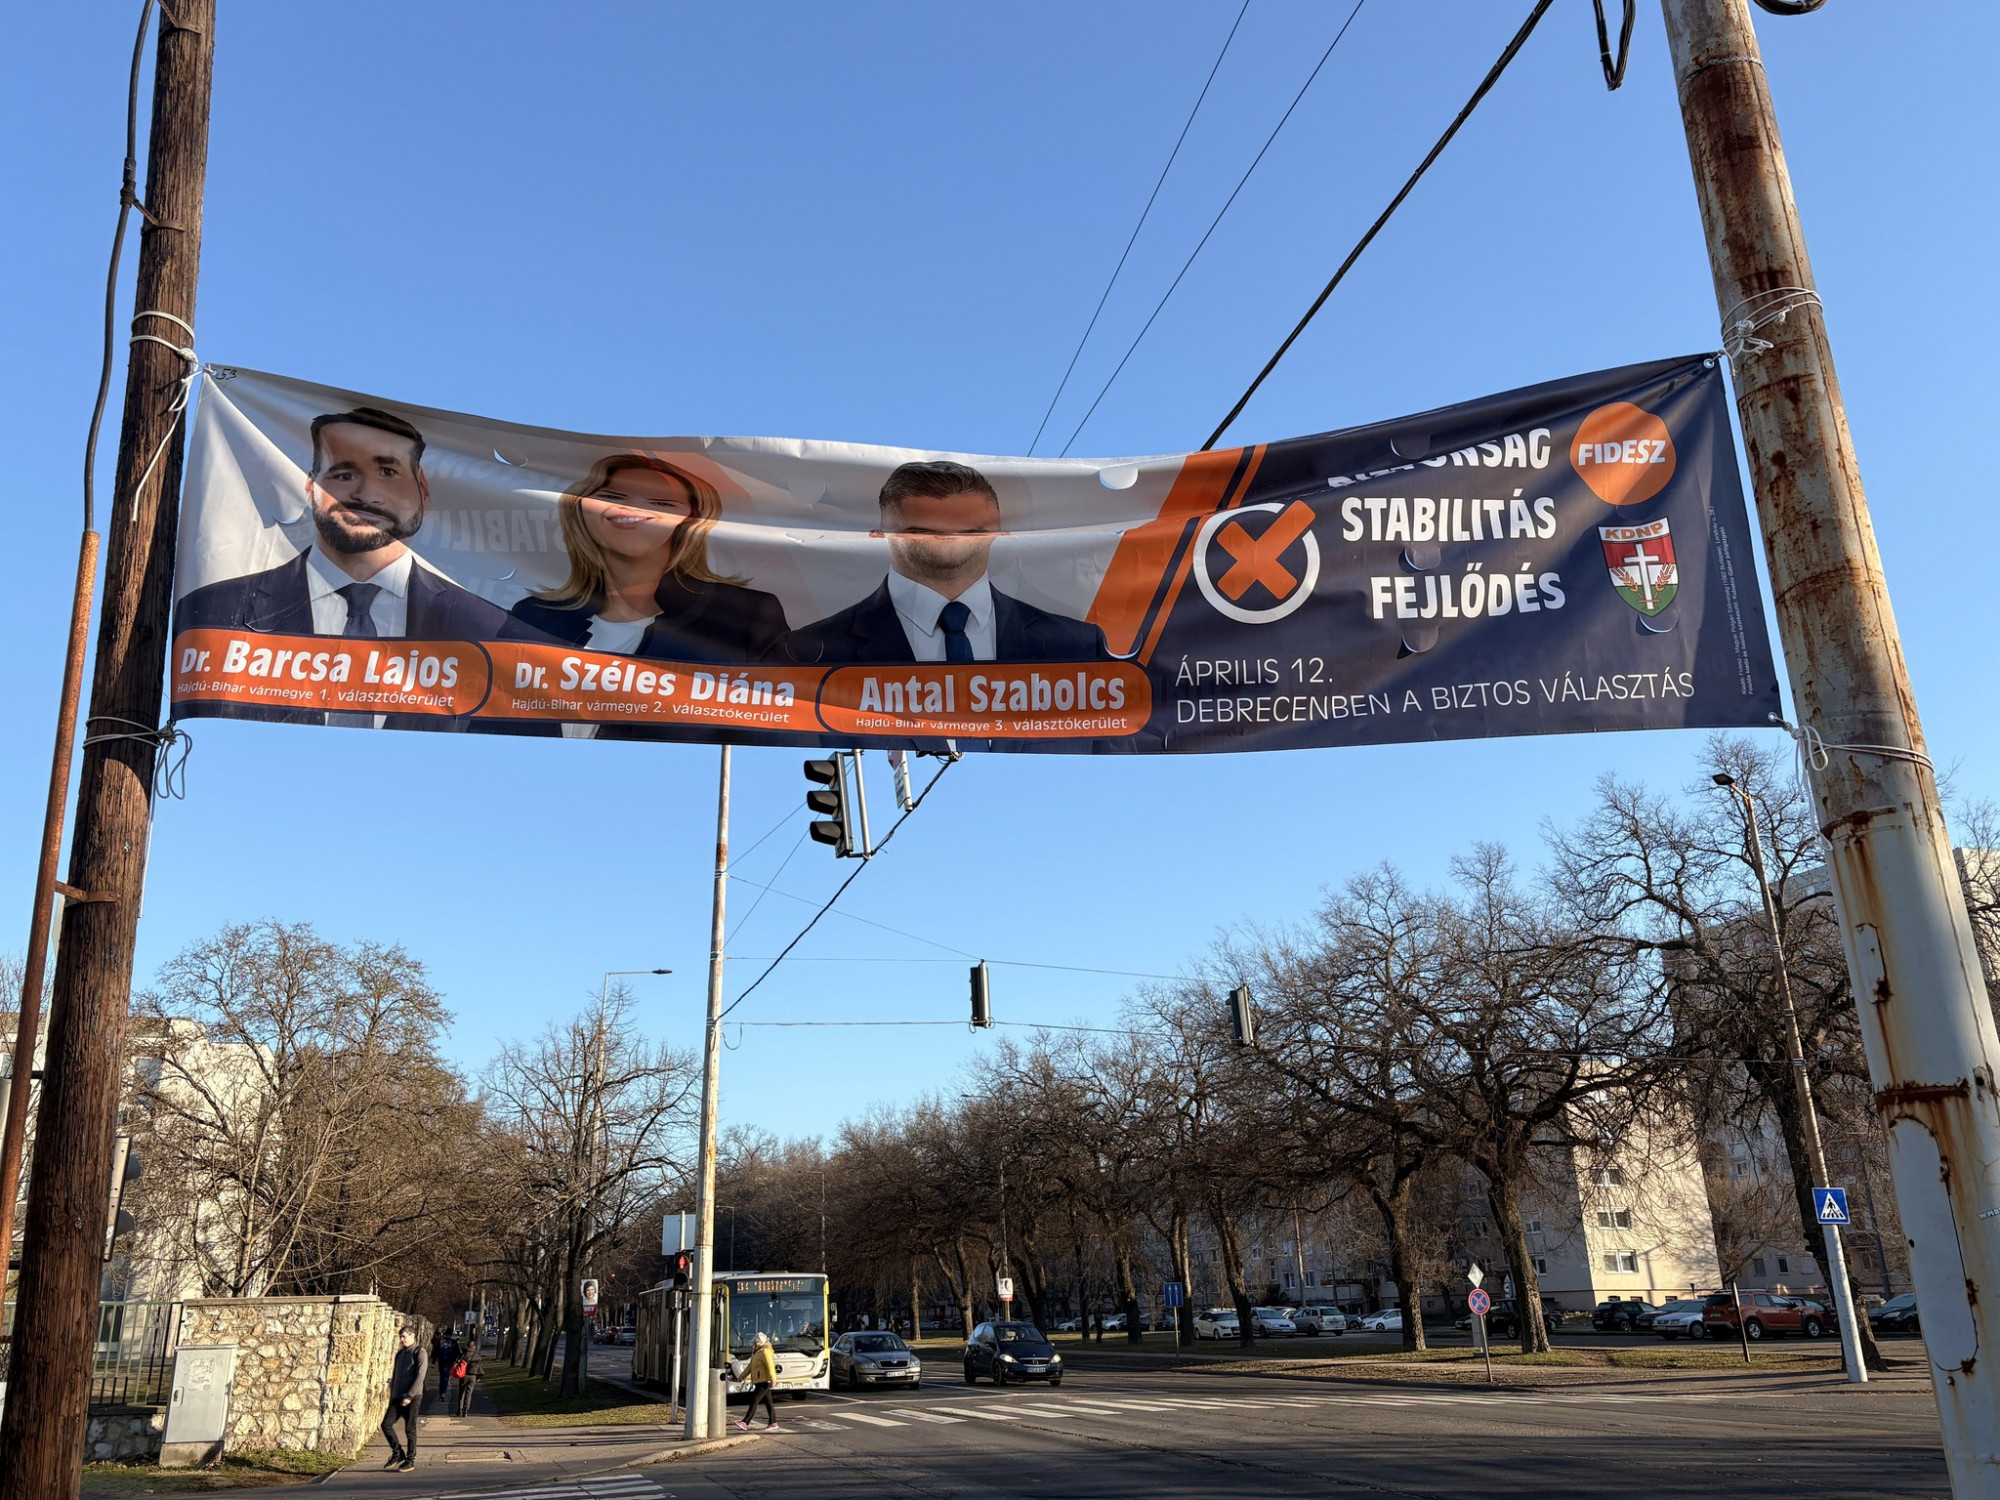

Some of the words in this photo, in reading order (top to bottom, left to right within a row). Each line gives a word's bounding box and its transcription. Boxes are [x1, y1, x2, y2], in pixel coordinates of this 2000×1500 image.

[1578, 439, 1666, 466] FIDESZ
[1341, 489, 1557, 542] STABILITÁS
[1605, 522, 1664, 540] KDNP
[1370, 562, 1566, 619] FEJLŐDÉS
[180, 647, 211, 674] Dr.
[222, 640, 351, 683] Barcsa
[363, 650, 459, 691] Lajos
[515, 662, 548, 689] Dr.
[560, 656, 676, 696] Széles
[690, 671, 795, 707] Diána
[1175, 655, 1280, 687] ÁPRILIS
[1291, 658, 1333, 684] 12.
[177, 681, 246, 694] Hajdú-Bihar
[249, 685, 313, 701] vármegye
[319, 689, 331, 700] 1.
[337, 689, 454, 707] választókerület
[511, 698, 583, 712] Hajdú-Bihar
[586, 699, 648, 714] vármegye
[653, 701, 666, 714] 2.
[672, 703, 790, 723] választókerület
[859, 675, 954, 713] Antal
[969, 672, 1125, 713] Szabolcs
[1177, 692, 1391, 723] DEBRECENBEN
[1402, 691, 1422, 713] A
[1432, 680, 1530, 710] BIZTOS
[1539, 666, 1696, 703] VÁLASZTÁS
[856, 717, 926, 729] Hajdú-Bihar
[929, 719, 990, 732] vármegye
[994, 720, 1008, 731] 3.
[1013, 717, 1127, 731] választókerület
